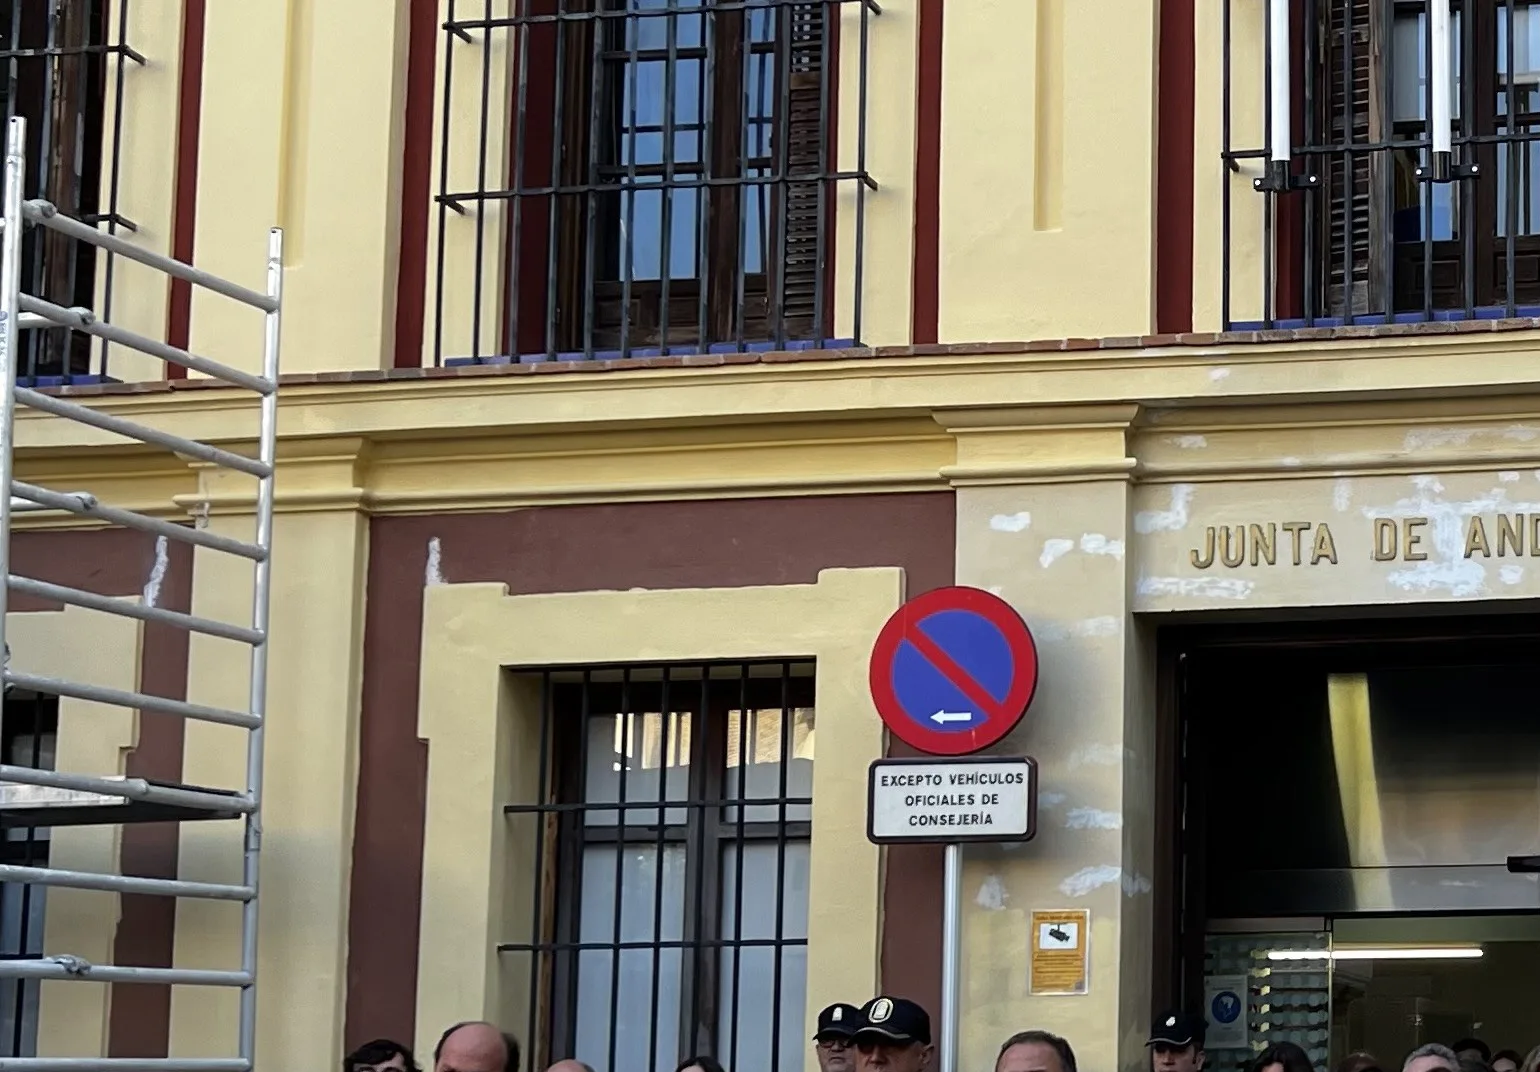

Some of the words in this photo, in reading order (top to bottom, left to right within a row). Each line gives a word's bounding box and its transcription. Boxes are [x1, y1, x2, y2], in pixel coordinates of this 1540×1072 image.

[1191, 522, 1338, 569] JUNTA
[1374, 517, 1428, 561] DE
[881, 774, 943, 787] EXCEPTO
[949, 771, 1024, 786] VEHÍCULOS
[904, 794, 975, 806] OFICIALES
[981, 793, 999, 805] DE
[908, 811, 993, 826] CONSEJERÍA
